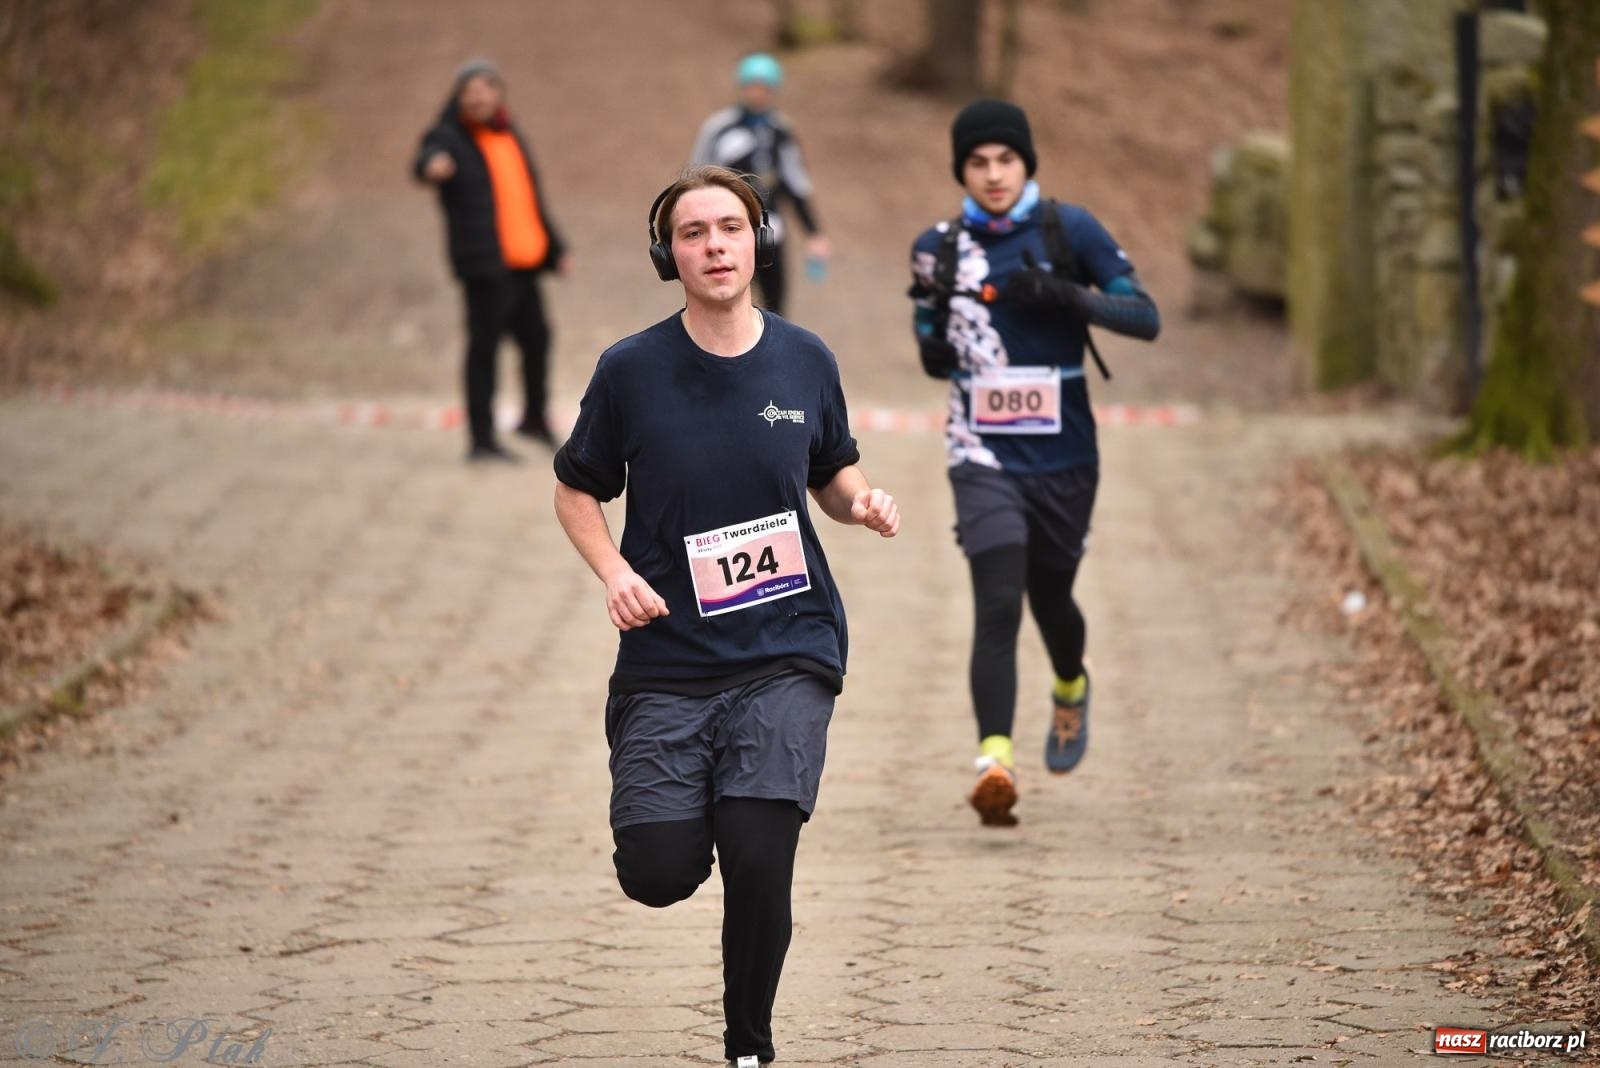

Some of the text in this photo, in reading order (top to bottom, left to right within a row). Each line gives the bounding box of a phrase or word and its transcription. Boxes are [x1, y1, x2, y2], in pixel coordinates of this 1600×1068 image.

[988, 389, 1042, 412] 080
[695, 517, 788, 548] BIEG Twardziela
[717, 545, 779, 587] 124
